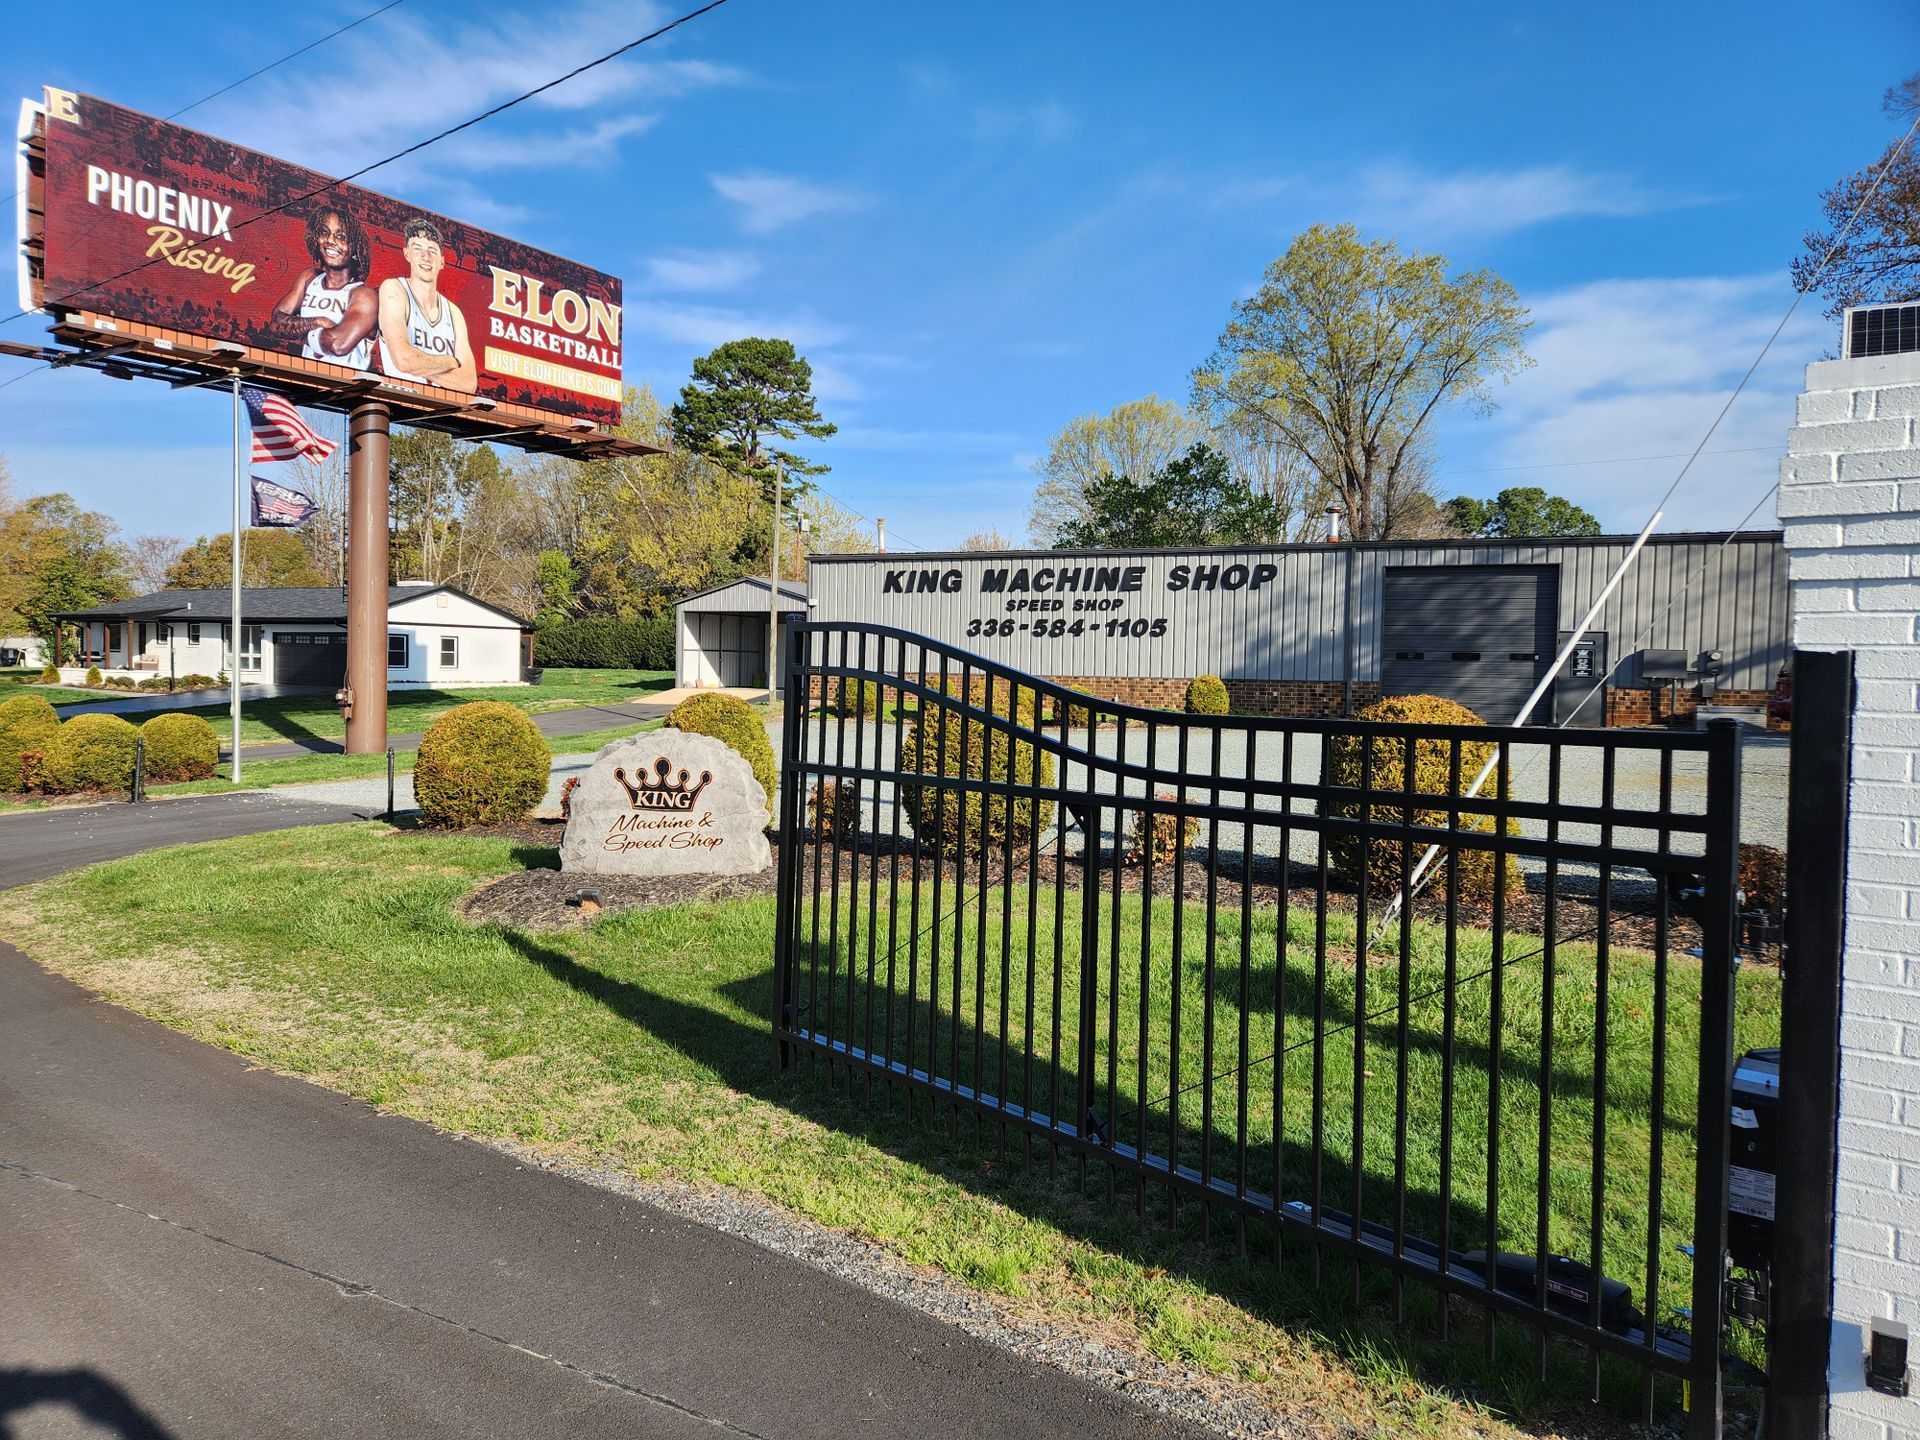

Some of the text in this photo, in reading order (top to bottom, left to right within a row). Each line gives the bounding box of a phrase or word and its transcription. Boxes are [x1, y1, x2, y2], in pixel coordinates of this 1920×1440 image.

[87, 164, 233, 242] PHOENIX
[146, 226, 256, 294] Rising
[301, 294, 347, 315] ELON
[488, 265, 622, 346] ELON
[414, 328, 455, 358] ELON
[490, 317, 622, 370] BASKETBALL
[490, 352, 618, 398] VISIT ELONTICKETS.COM
[883, 564, 1278, 594] KING MACHINE SHOP
[1005, 599, 1124, 612] SPEED SHOP
[966, 618, 1168, 638] 336-584-1105
[634, 790, 692, 808] KING
[609, 811, 715, 833] Machine &
[603, 832, 724, 854] Speed Shop
